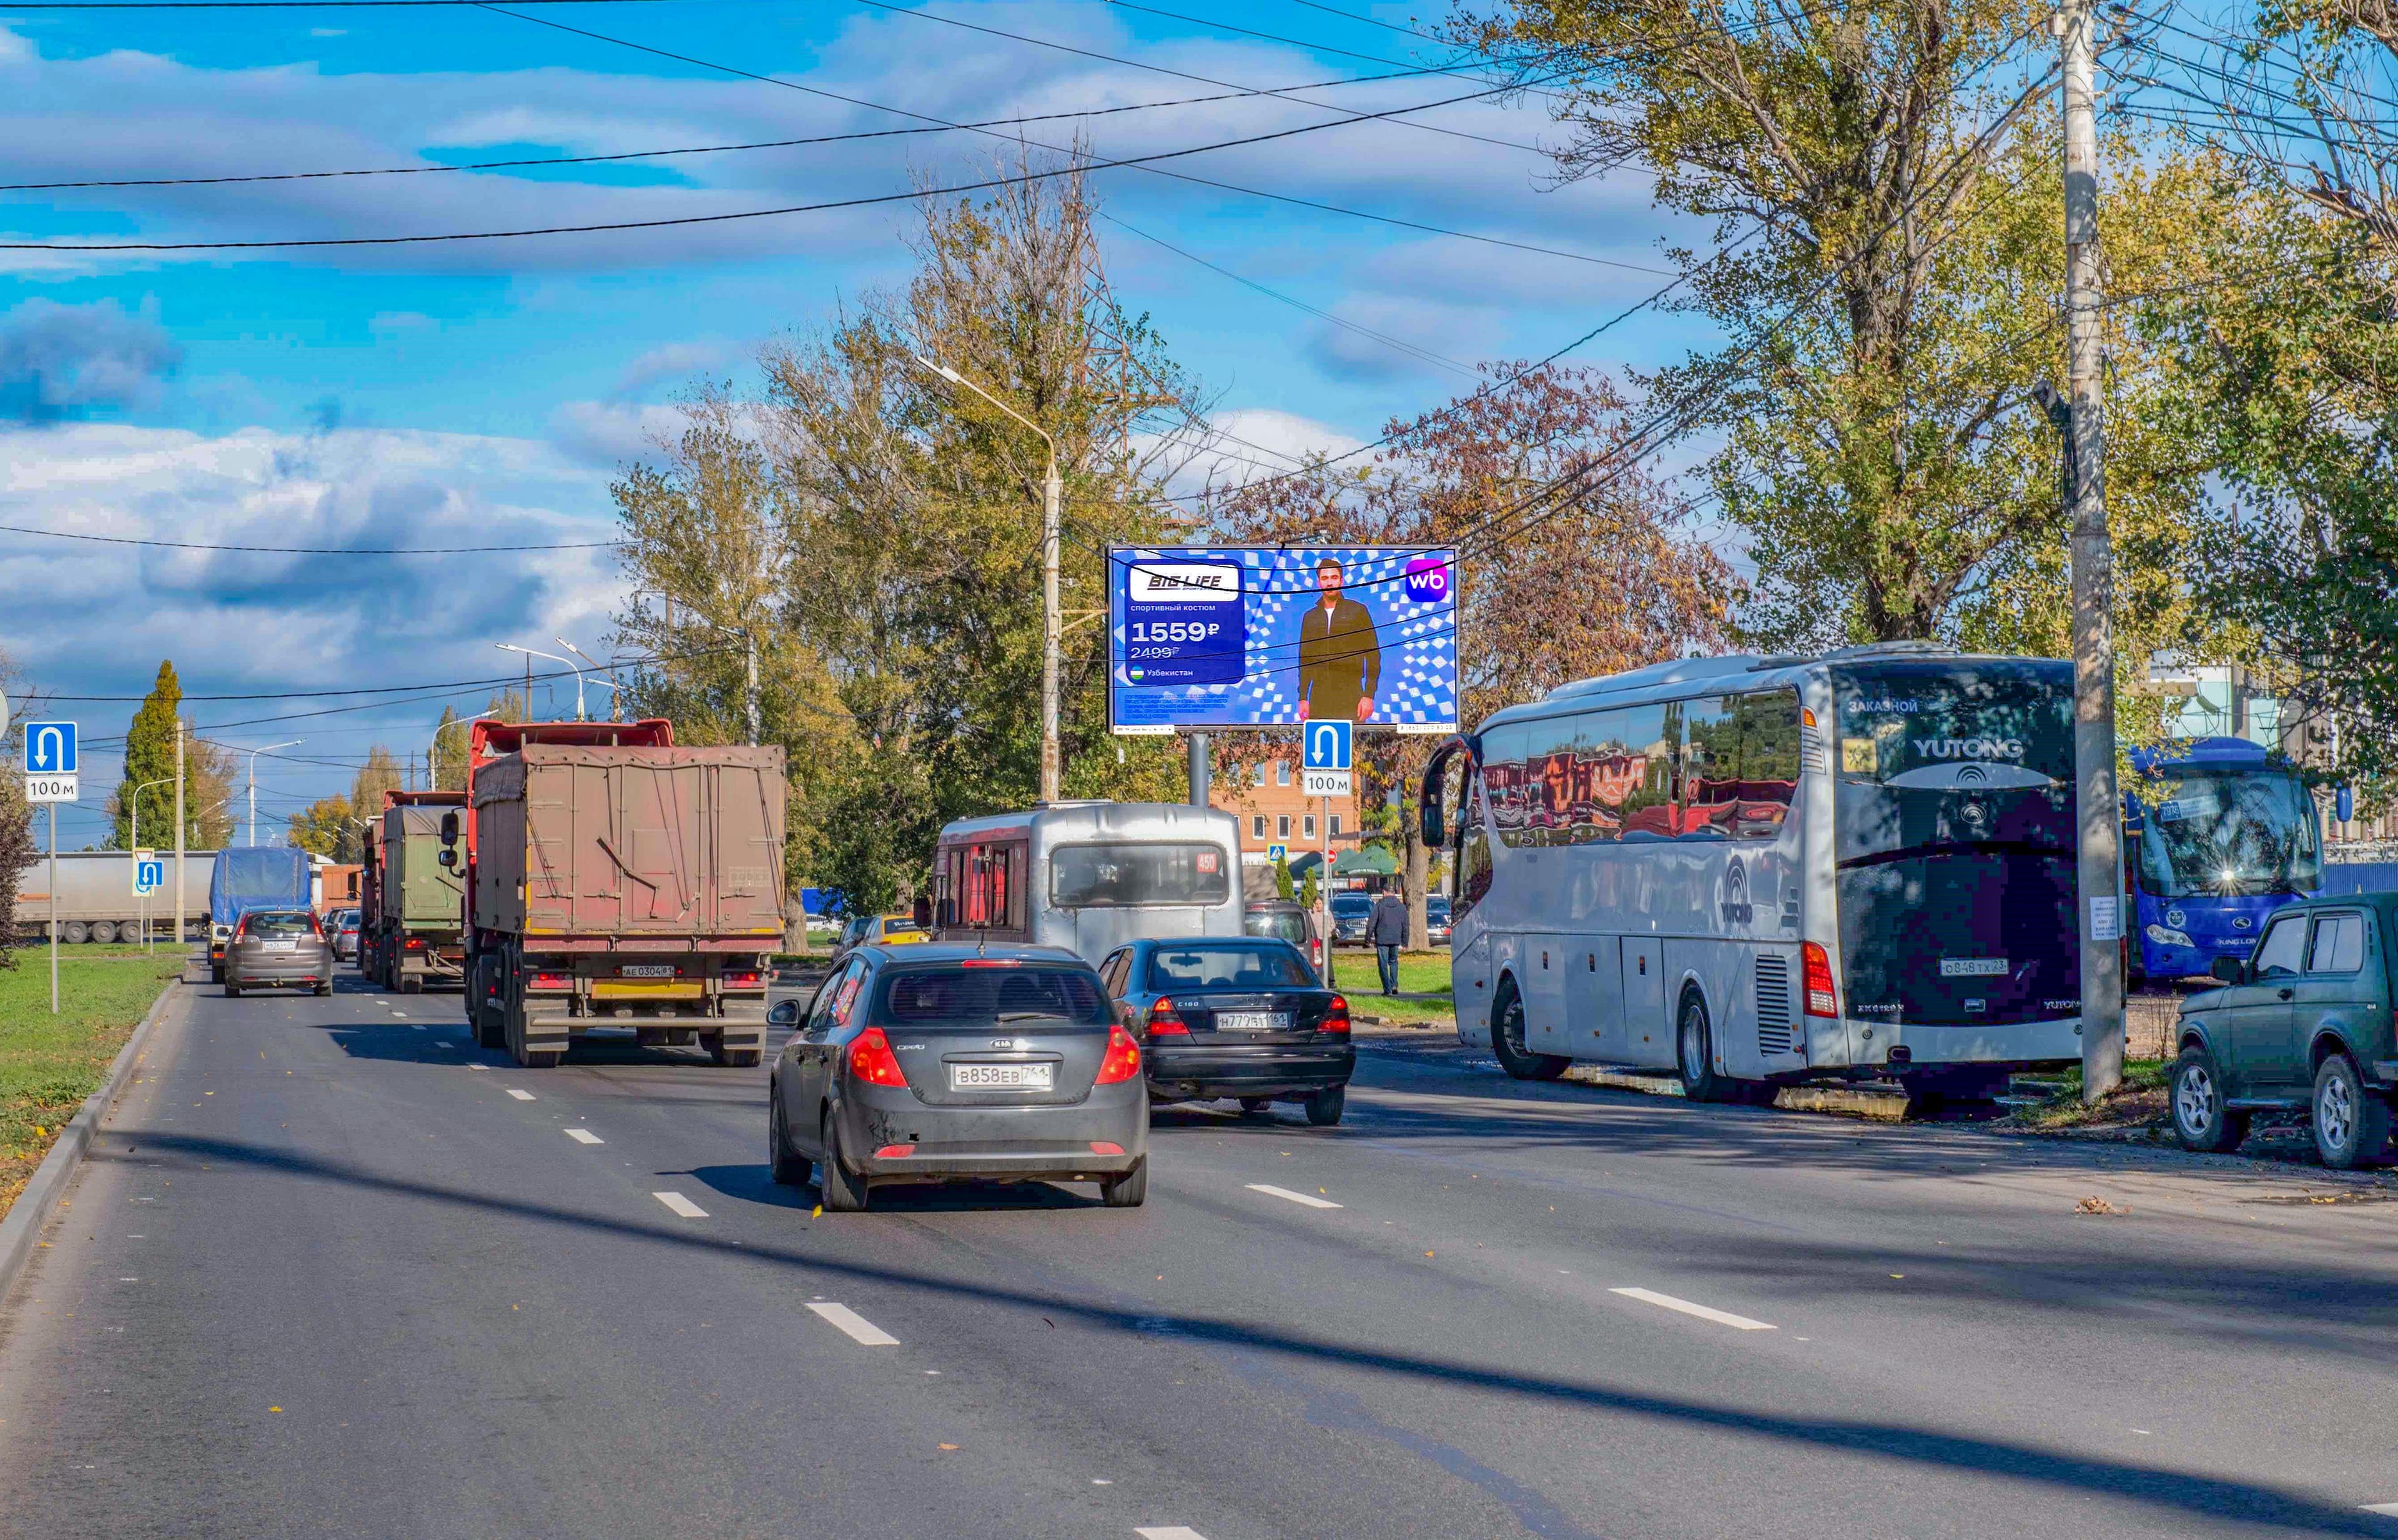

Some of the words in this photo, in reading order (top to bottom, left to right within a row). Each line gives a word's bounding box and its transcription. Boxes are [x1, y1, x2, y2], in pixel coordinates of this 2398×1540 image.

[1148, 575, 1181, 587] BIG
[1408, 569, 1444, 590] wb
[1130, 605, 1182, 613] спортивный
[1848, 698, 1918, 713] ЗАКАЗНОЙ
[1913, 739, 2023, 758] YUTONG
[31, 781, 60, 796] 100
[1308, 777, 1335, 790] 100
[1199, 854, 1215, 870] 450
[1720, 903, 1753, 924] YUTONG
[2043, 1000, 2081, 1010] YUTON
[960, 1068, 1020, 1083] В858ЕВ
